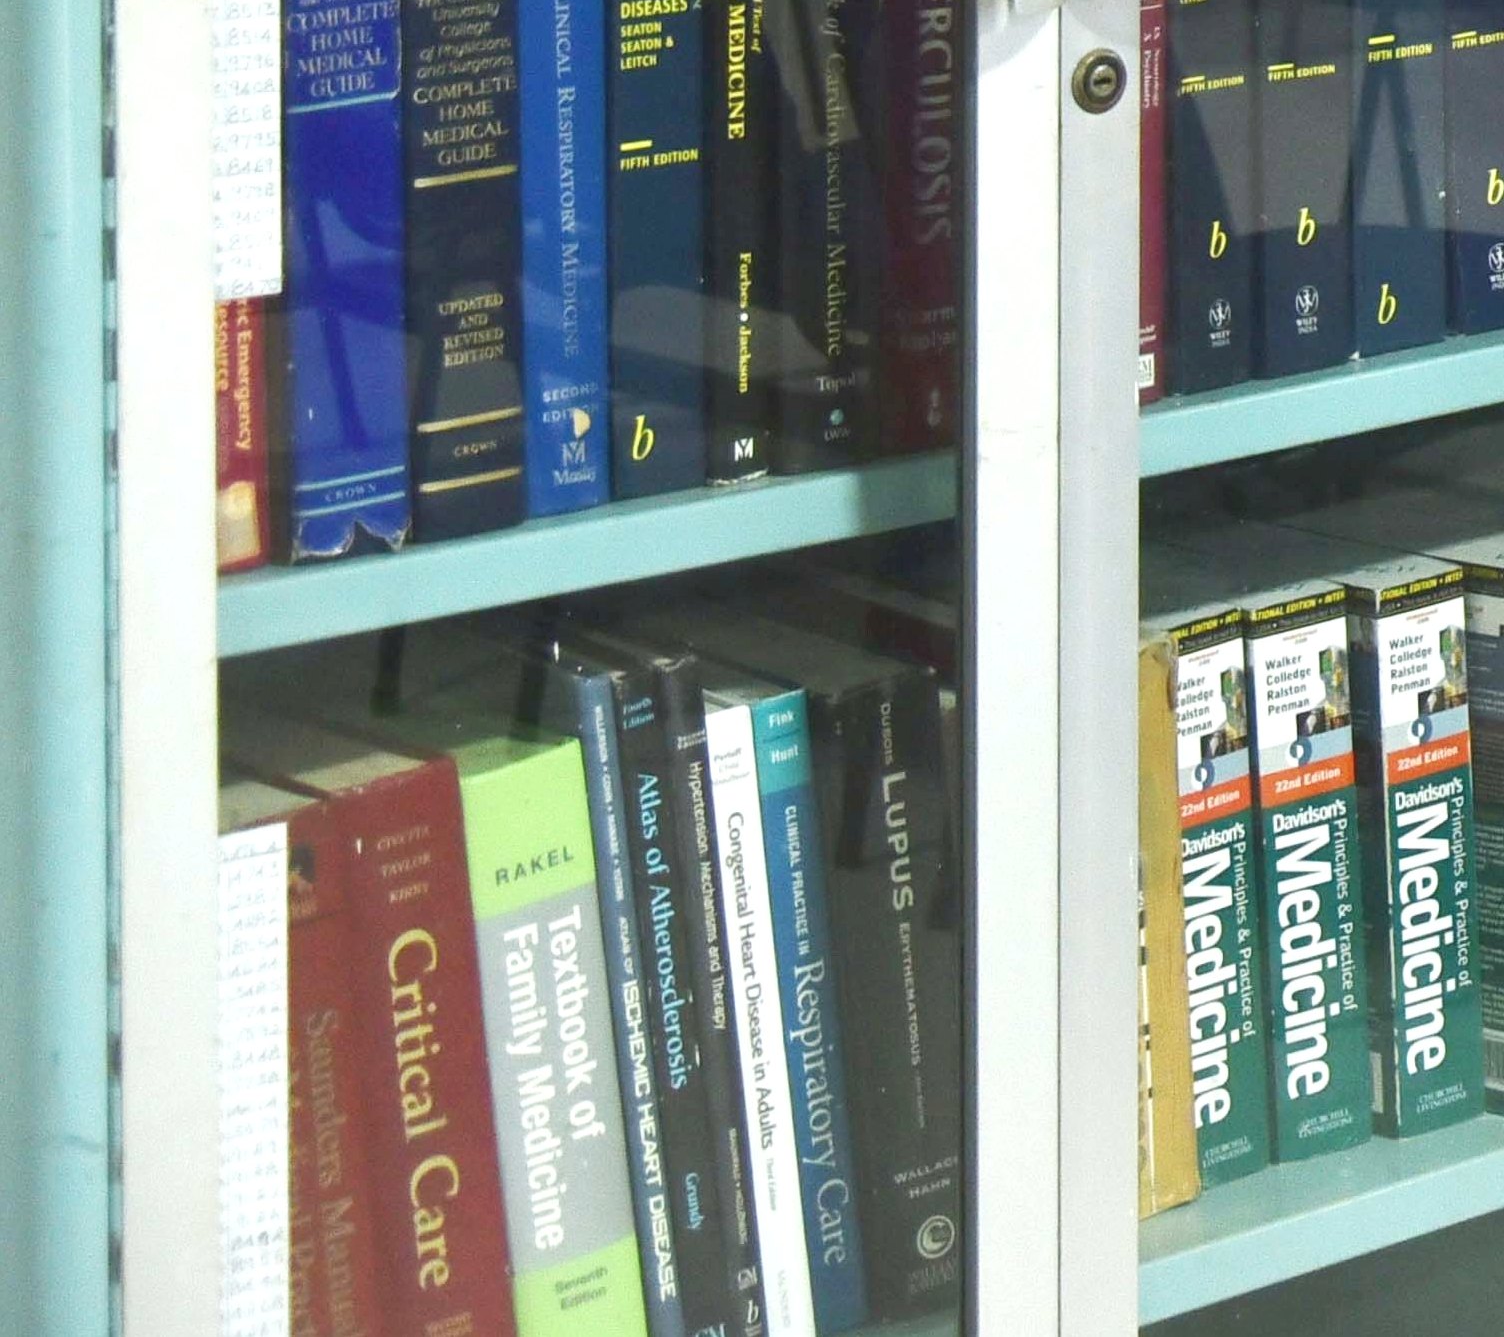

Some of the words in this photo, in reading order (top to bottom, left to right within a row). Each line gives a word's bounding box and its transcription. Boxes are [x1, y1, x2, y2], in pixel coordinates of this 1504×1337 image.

[727, 2, 745, 141] MEDICINE
[556, 84, 579, 236] RESPIRATORY
[562, 244, 582, 359] MEDICINE
[738, 251, 753, 307] Forbes
[738, 324, 753, 394] Jackson
[1265, 652, 1302, 671] Walker
[1265, 665, 1312, 687] Colledge
[1266, 681, 1308, 702] Ralston
[1267, 696, 1311, 717] Penman
[637, 771, 661, 840] Atlas
[1272, 799, 1347, 832] Davidson's
[1274, 773, 1304, 794] 22nd
[1305, 763, 1342, 785] Edition
[1394, 777, 1464, 812] Davidson's
[494, 845, 576, 887] RAKEL
[880, 769, 914, 913] LUPUS
[502, 920, 545, 1059] Family
[647, 881, 688, 1091] Atherosclerosis
[1183, 845, 1233, 1128] Medicine
[1275, 825, 1342, 1101] Medicine
[1396, 801, 1457, 1076] Medicine
[387, 926, 441, 1145] Critical
[545, 905, 597, 1095] Textbook
[795, 957, 840, 1168] Respiratory
[517, 1065, 565, 1252] Medicine
[569, 1104, 607, 1143] of
[408, 1152, 460, 1291] Care
[814, 1178, 848, 1266] Care
